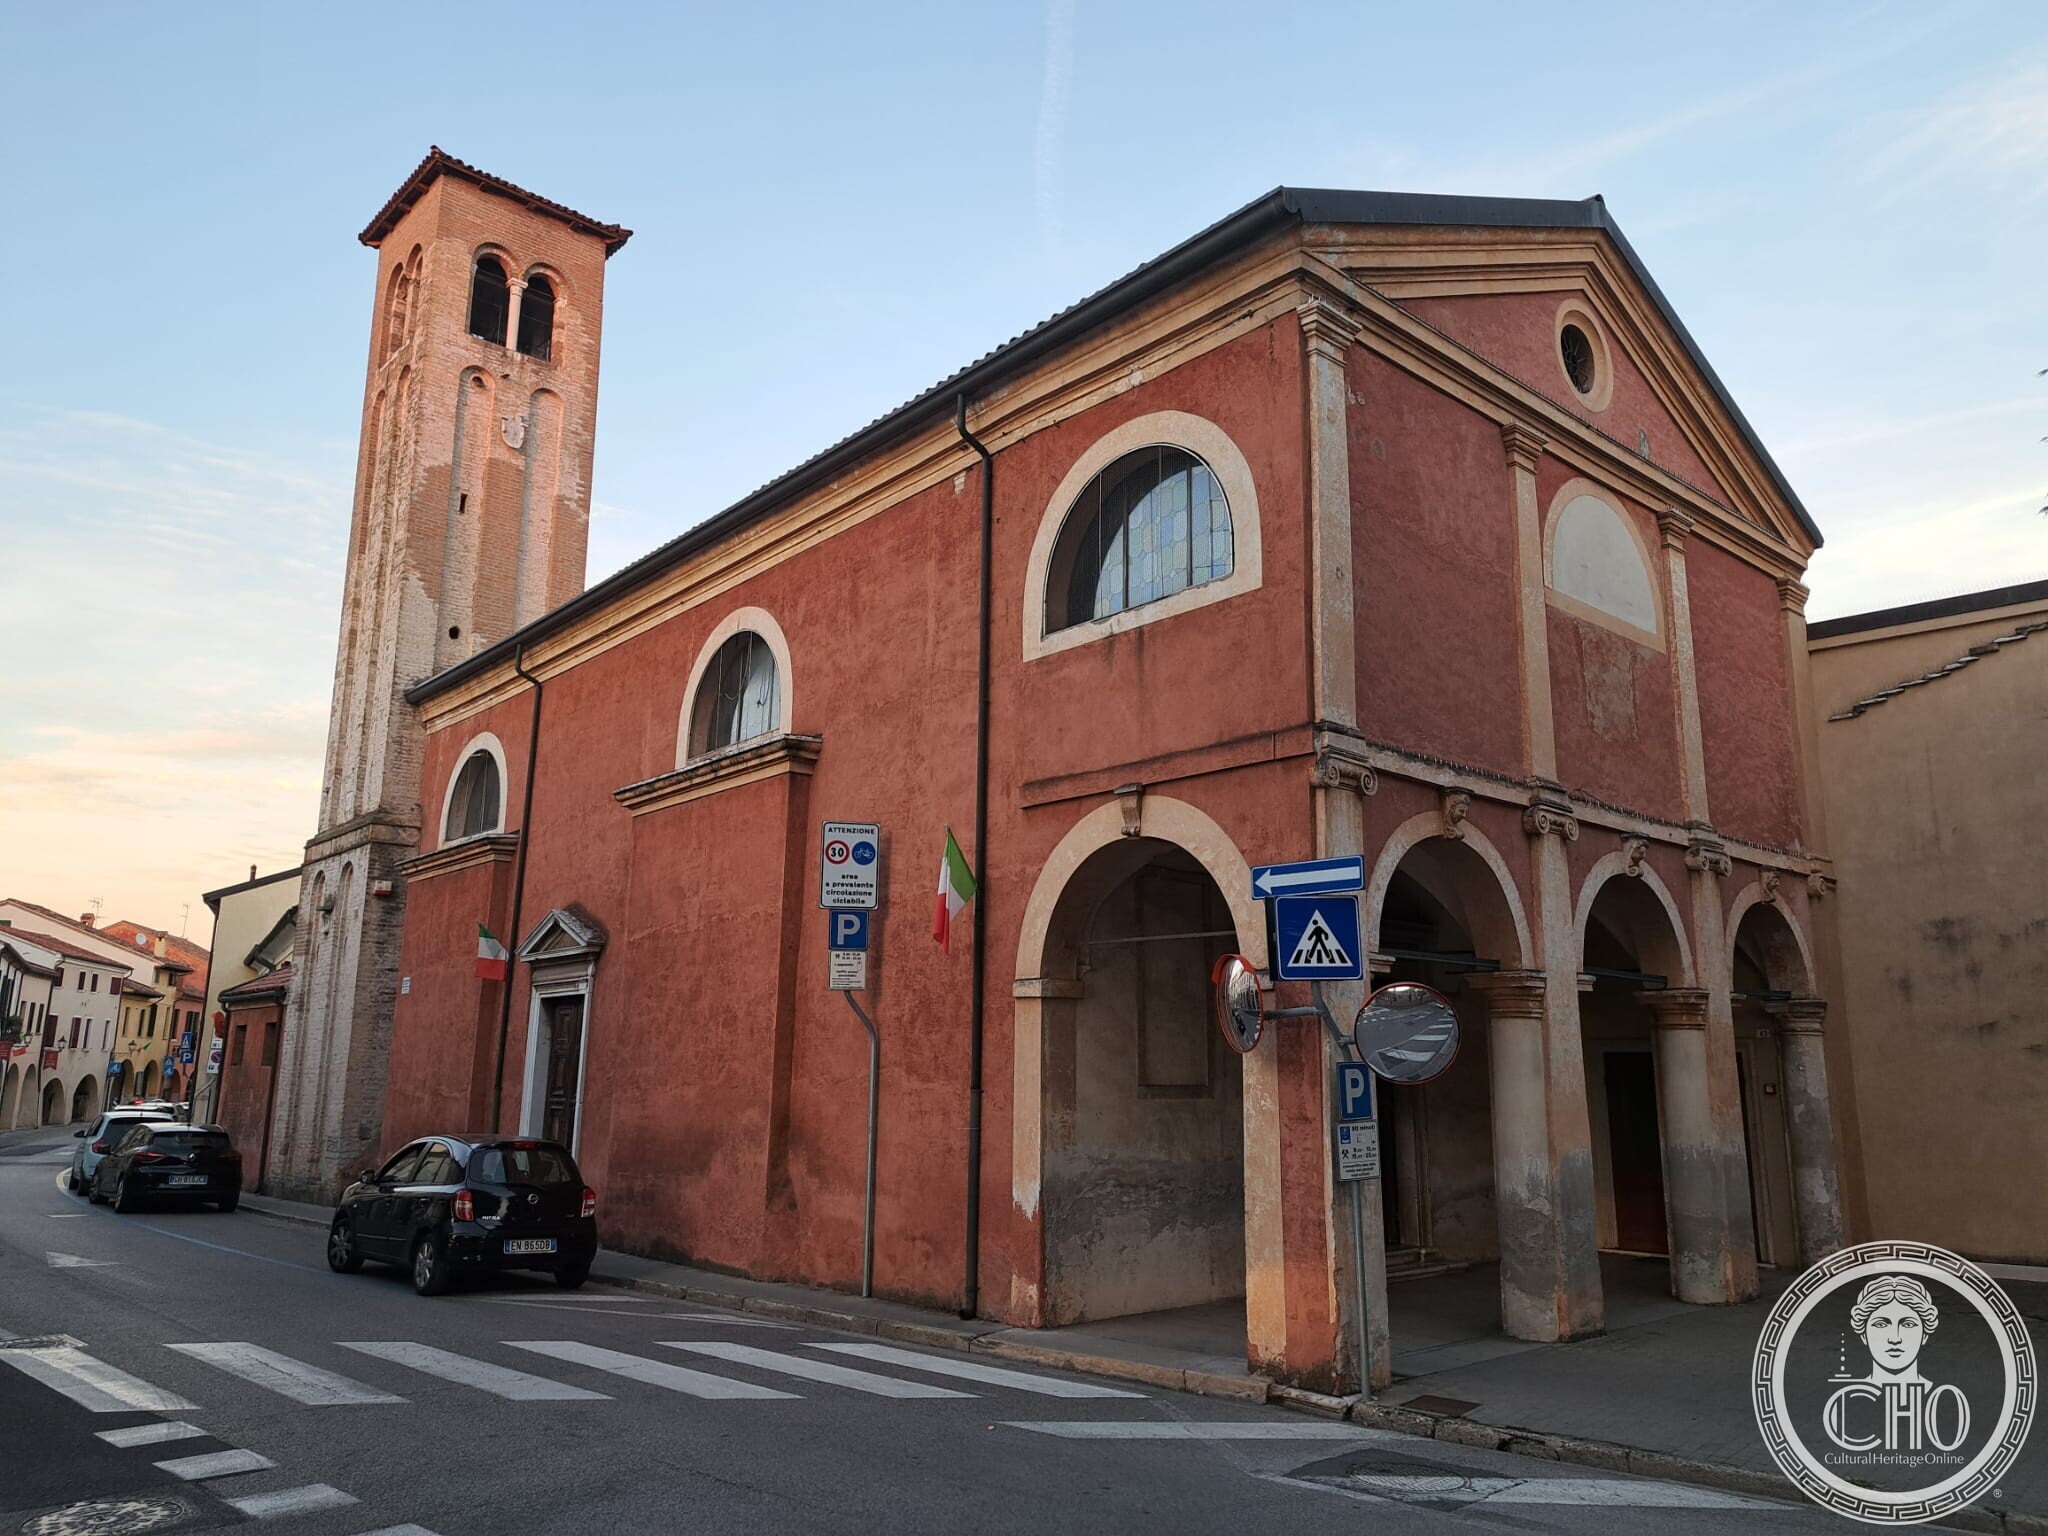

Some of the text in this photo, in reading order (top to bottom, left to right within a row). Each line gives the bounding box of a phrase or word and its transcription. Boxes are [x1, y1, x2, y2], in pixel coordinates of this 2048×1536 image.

[828, 827, 875, 835] ATTENZIONE
[830, 847, 845, 858] 30
[832, 881, 874, 889] prevalente
[826, 889, 872, 897] circolazione
[837, 914, 861, 945] P
[182, 1052, 192, 1063] P
[1344, 1068, 1365, 1114] P
[511, 1241, 522, 1251] EN
